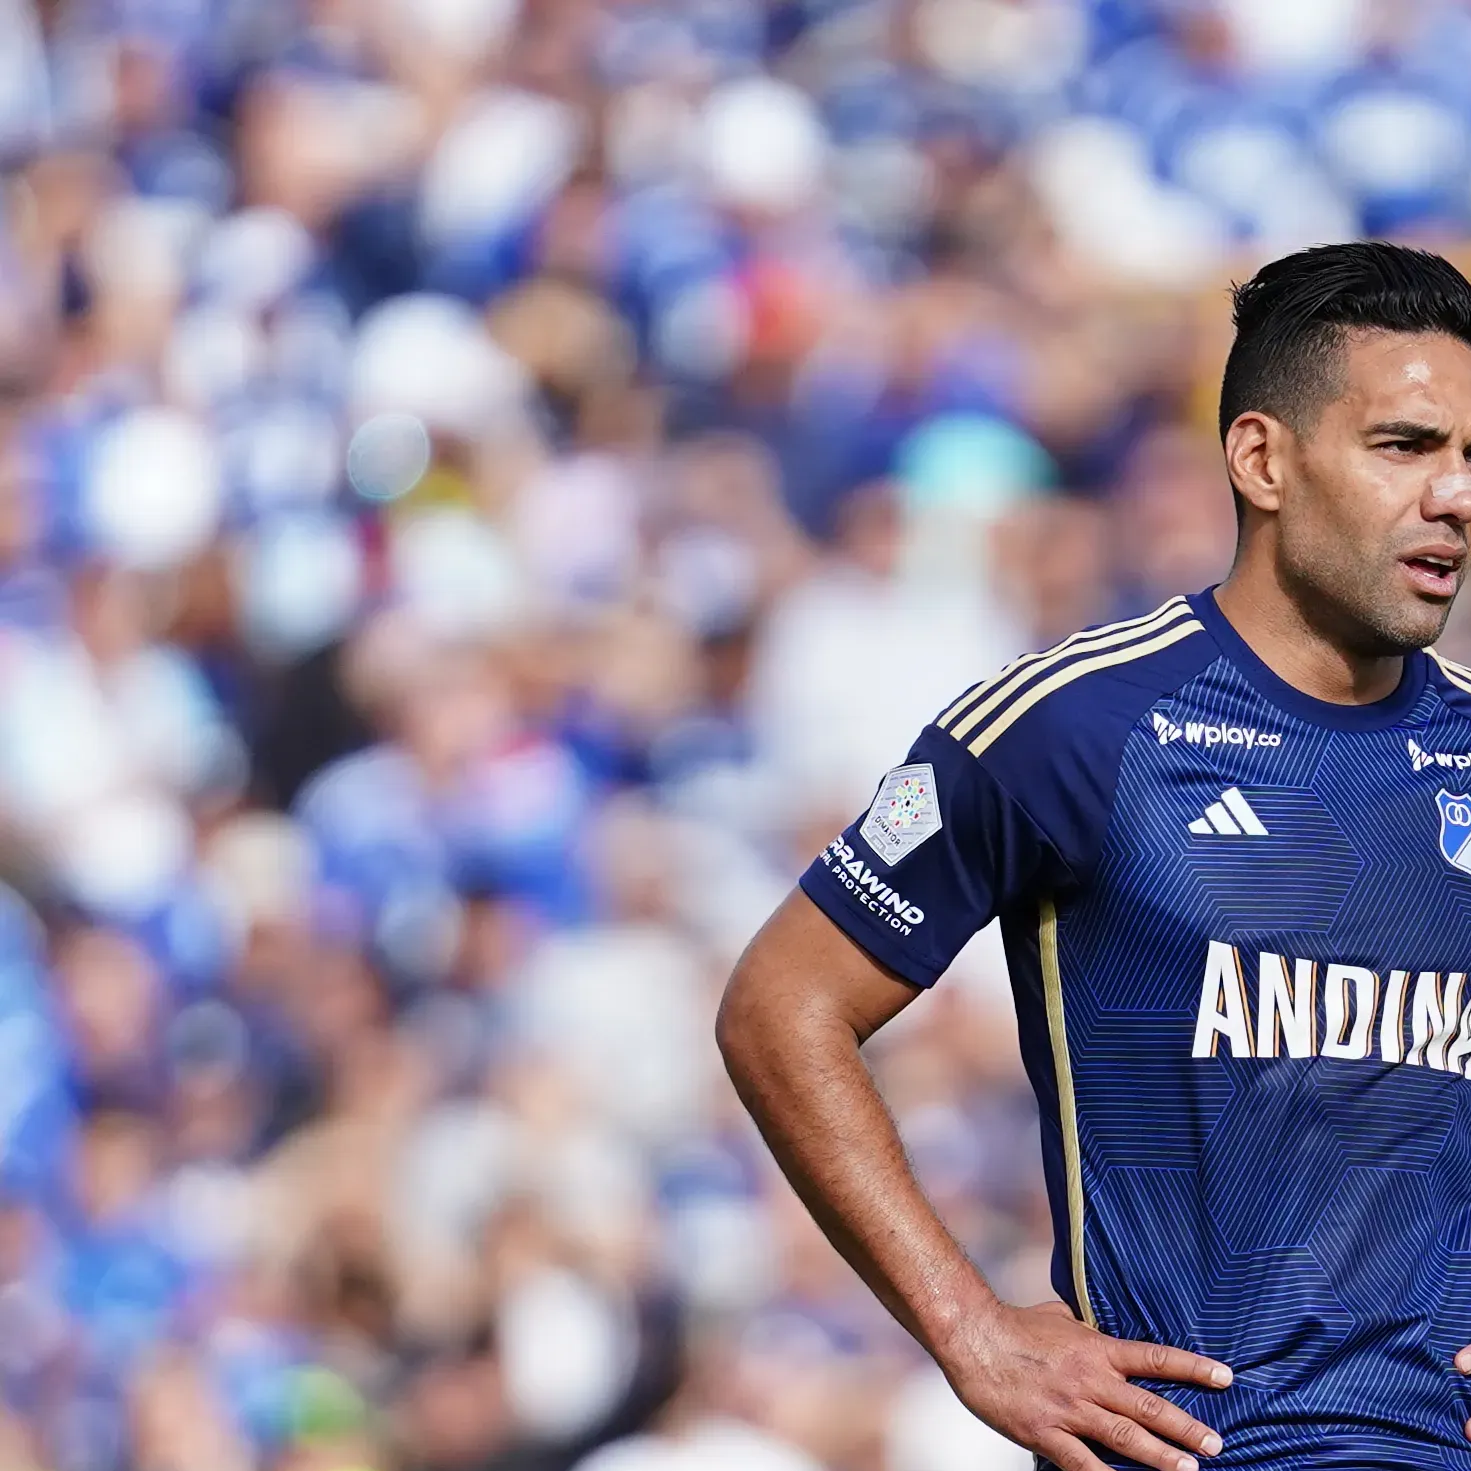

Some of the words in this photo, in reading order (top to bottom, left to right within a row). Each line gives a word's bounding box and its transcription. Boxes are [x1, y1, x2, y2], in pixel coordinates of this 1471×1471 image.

[1185, 721, 1282, 750] Wplay.co
[873, 815, 901, 847] DIMAYOR
[829, 833, 925, 925] RRAWIND
[831, 865, 913, 937] PROTECTION
